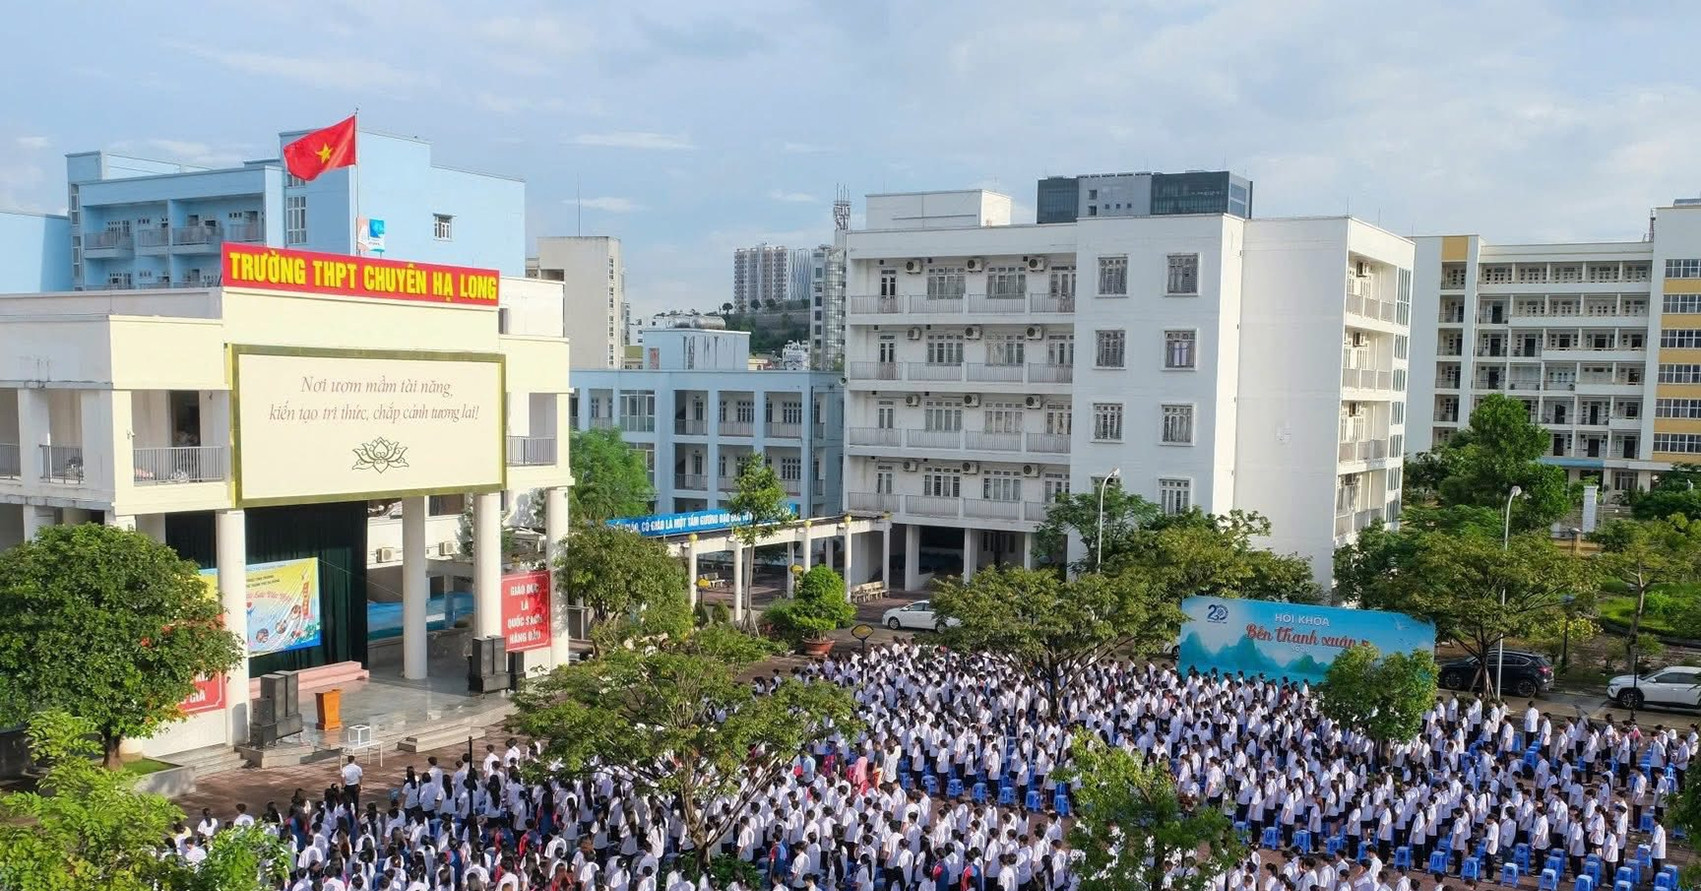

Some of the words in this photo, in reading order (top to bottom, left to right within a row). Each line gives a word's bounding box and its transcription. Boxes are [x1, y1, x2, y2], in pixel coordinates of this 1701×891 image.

[229, 250, 307, 285] TRƯỜNG
[312, 260, 358, 289] THPT
[363, 263, 427, 295] CHUYÊN
[432, 271, 453, 302] HẠ
[459, 274, 497, 300] LONG
[300, 376, 327, 393] Nơi
[331, 381, 361, 393] ươm
[400, 378, 417, 393] tài
[420, 380, 453, 399] năng,
[269, 400, 295, 421] kiến
[299, 408, 319, 424] tạo
[340, 404, 370, 422] thức,
[373, 402, 401, 424] chắp
[402, 404, 429, 420] cánh
[641, 519, 650, 532] CÔ
[665, 517, 674, 530] LÀ
[674, 516, 688, 531] MỘT
[511, 583, 525, 596] GIÁO
[521, 599, 529, 611] LÀ
[508, 614, 525, 629] QUỐC
[510, 631, 527, 644] HÀNG
